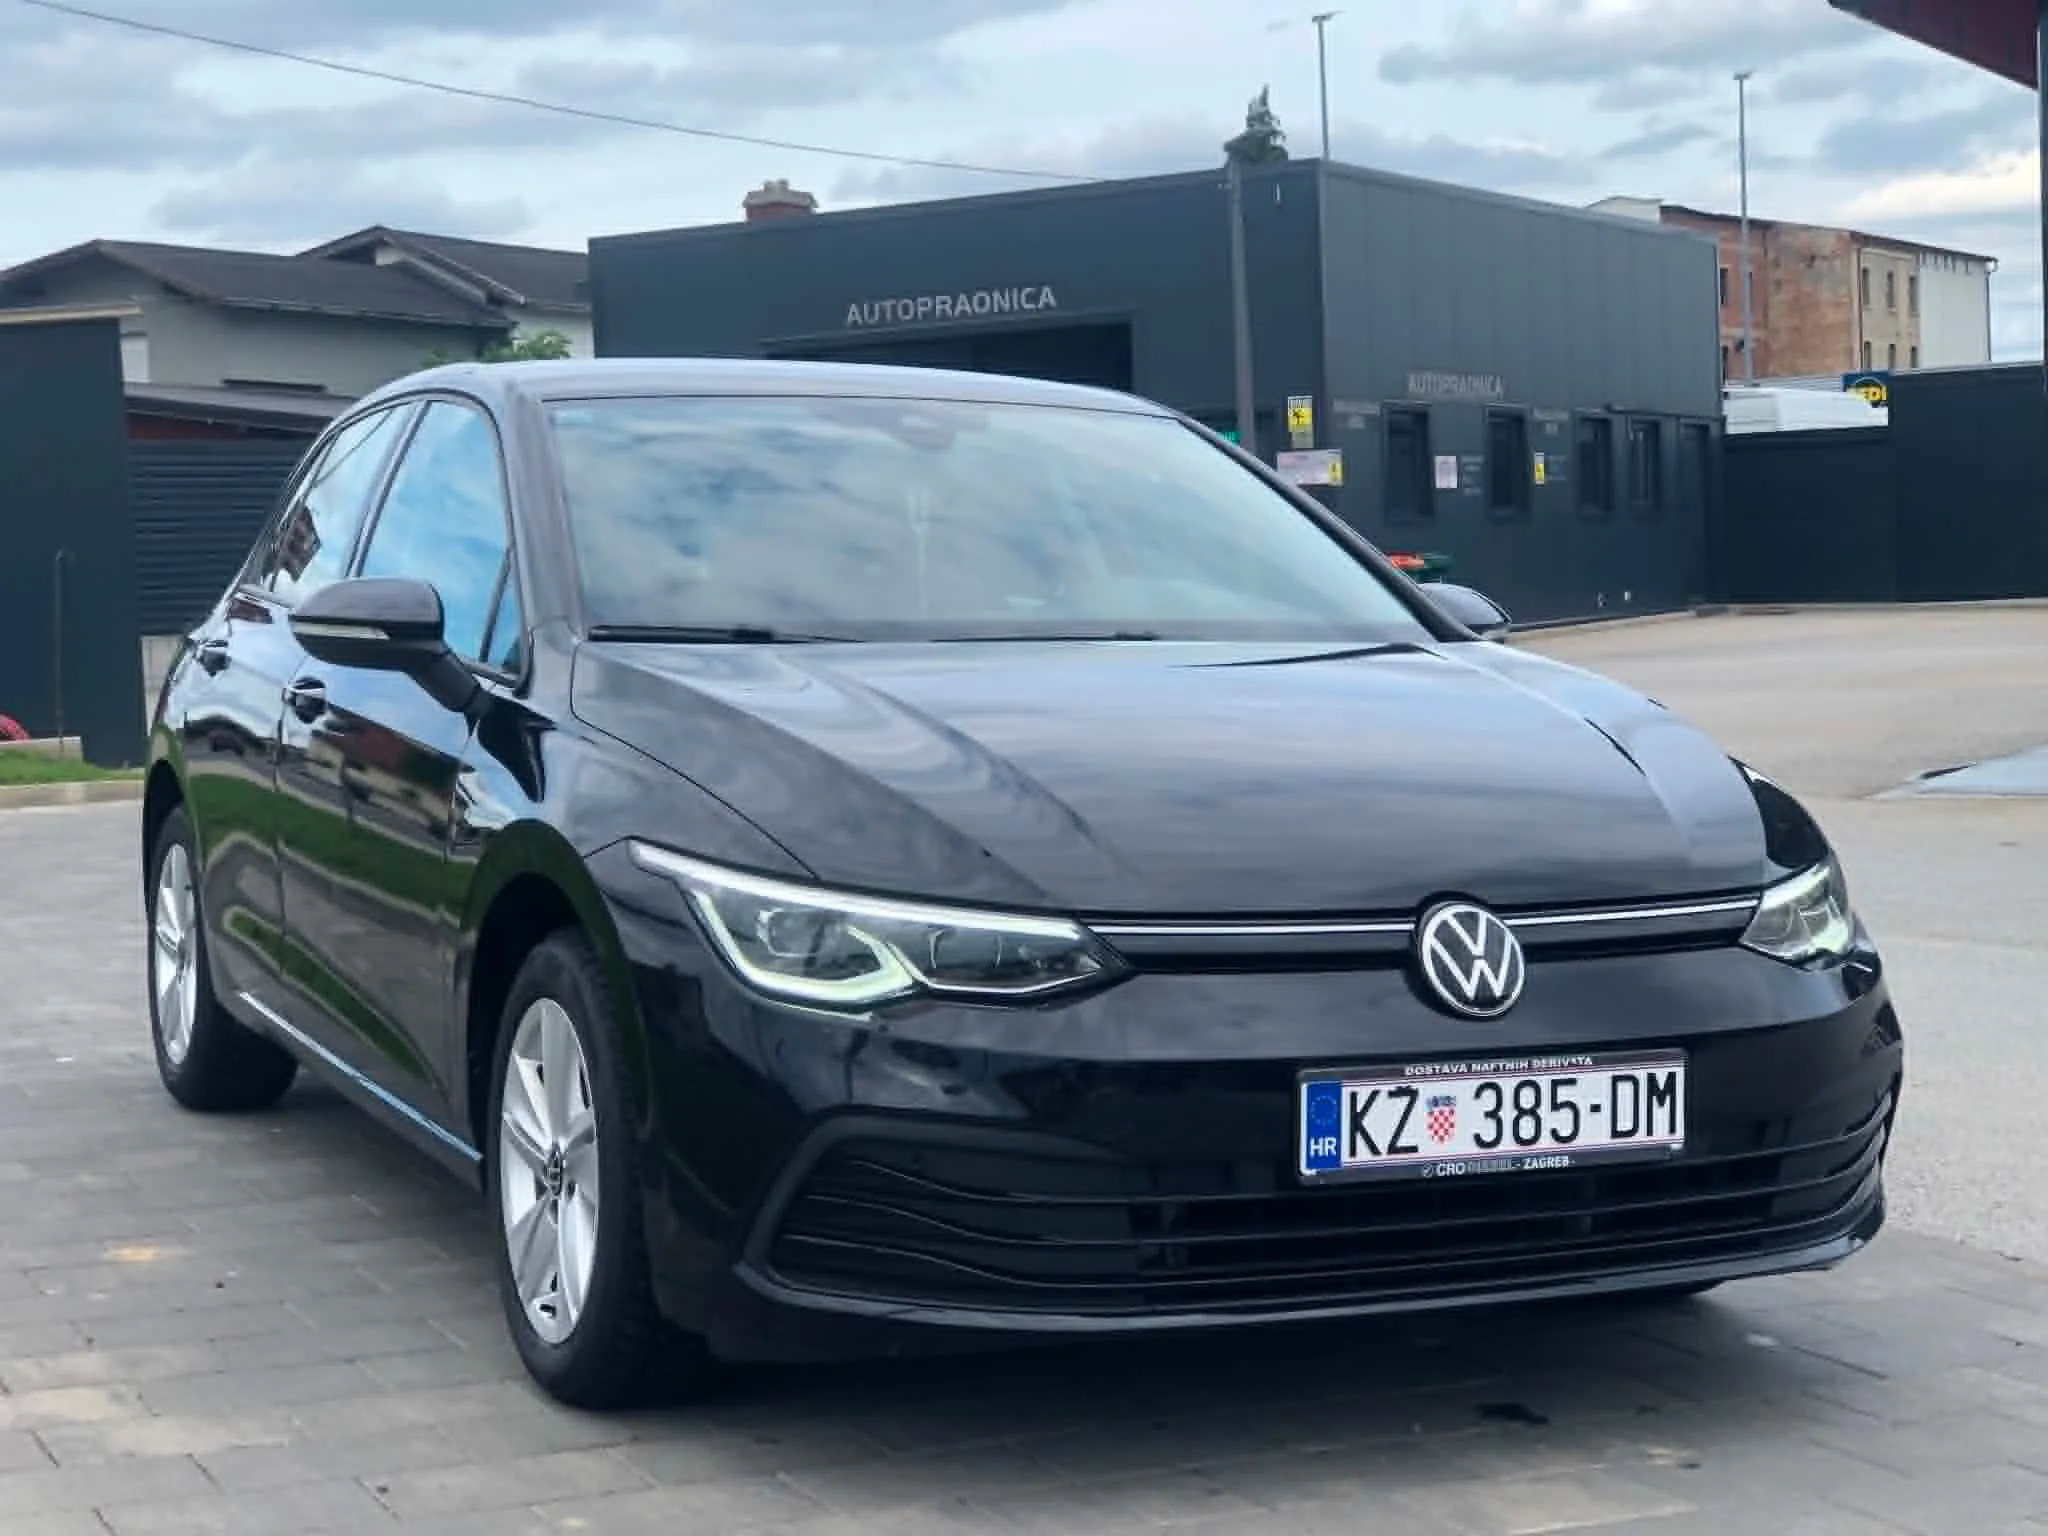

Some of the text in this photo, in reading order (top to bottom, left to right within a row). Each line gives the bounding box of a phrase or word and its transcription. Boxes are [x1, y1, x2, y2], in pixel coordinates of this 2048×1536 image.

[847, 285, 1057, 325] AUTOPRAONICA
[1404, 1062, 1468, 1076] DOSTAVA
[1472, 1071, 1677, 1150] 385-DM
[1309, 1136, 1337, 1157] HR
